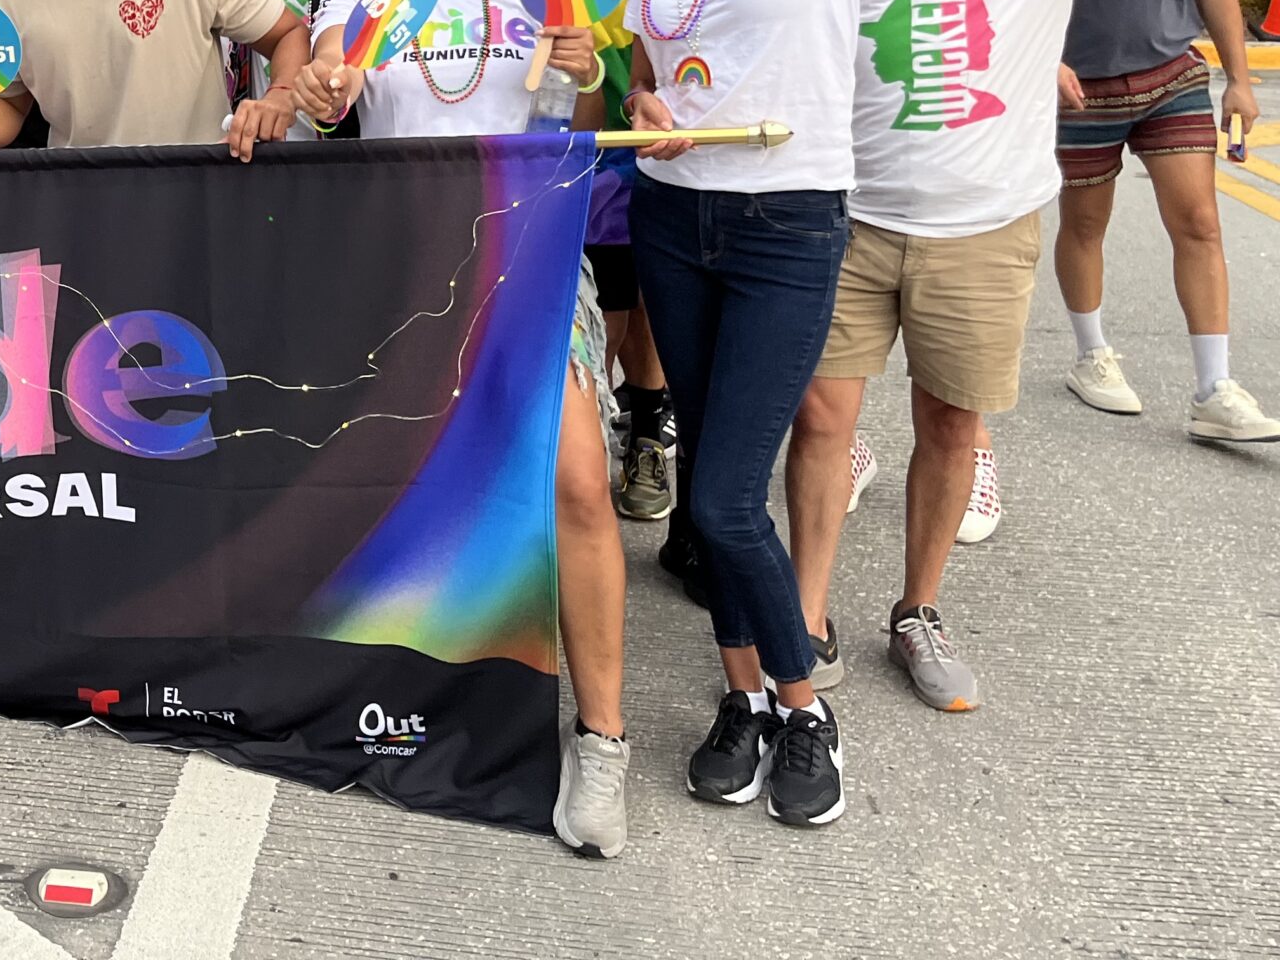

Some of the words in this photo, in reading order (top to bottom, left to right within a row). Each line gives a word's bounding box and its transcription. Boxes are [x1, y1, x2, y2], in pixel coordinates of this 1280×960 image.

[403, 51, 420, 62] IS
[163, 686, 183, 705] EL
[358, 702, 426, 737] Out
